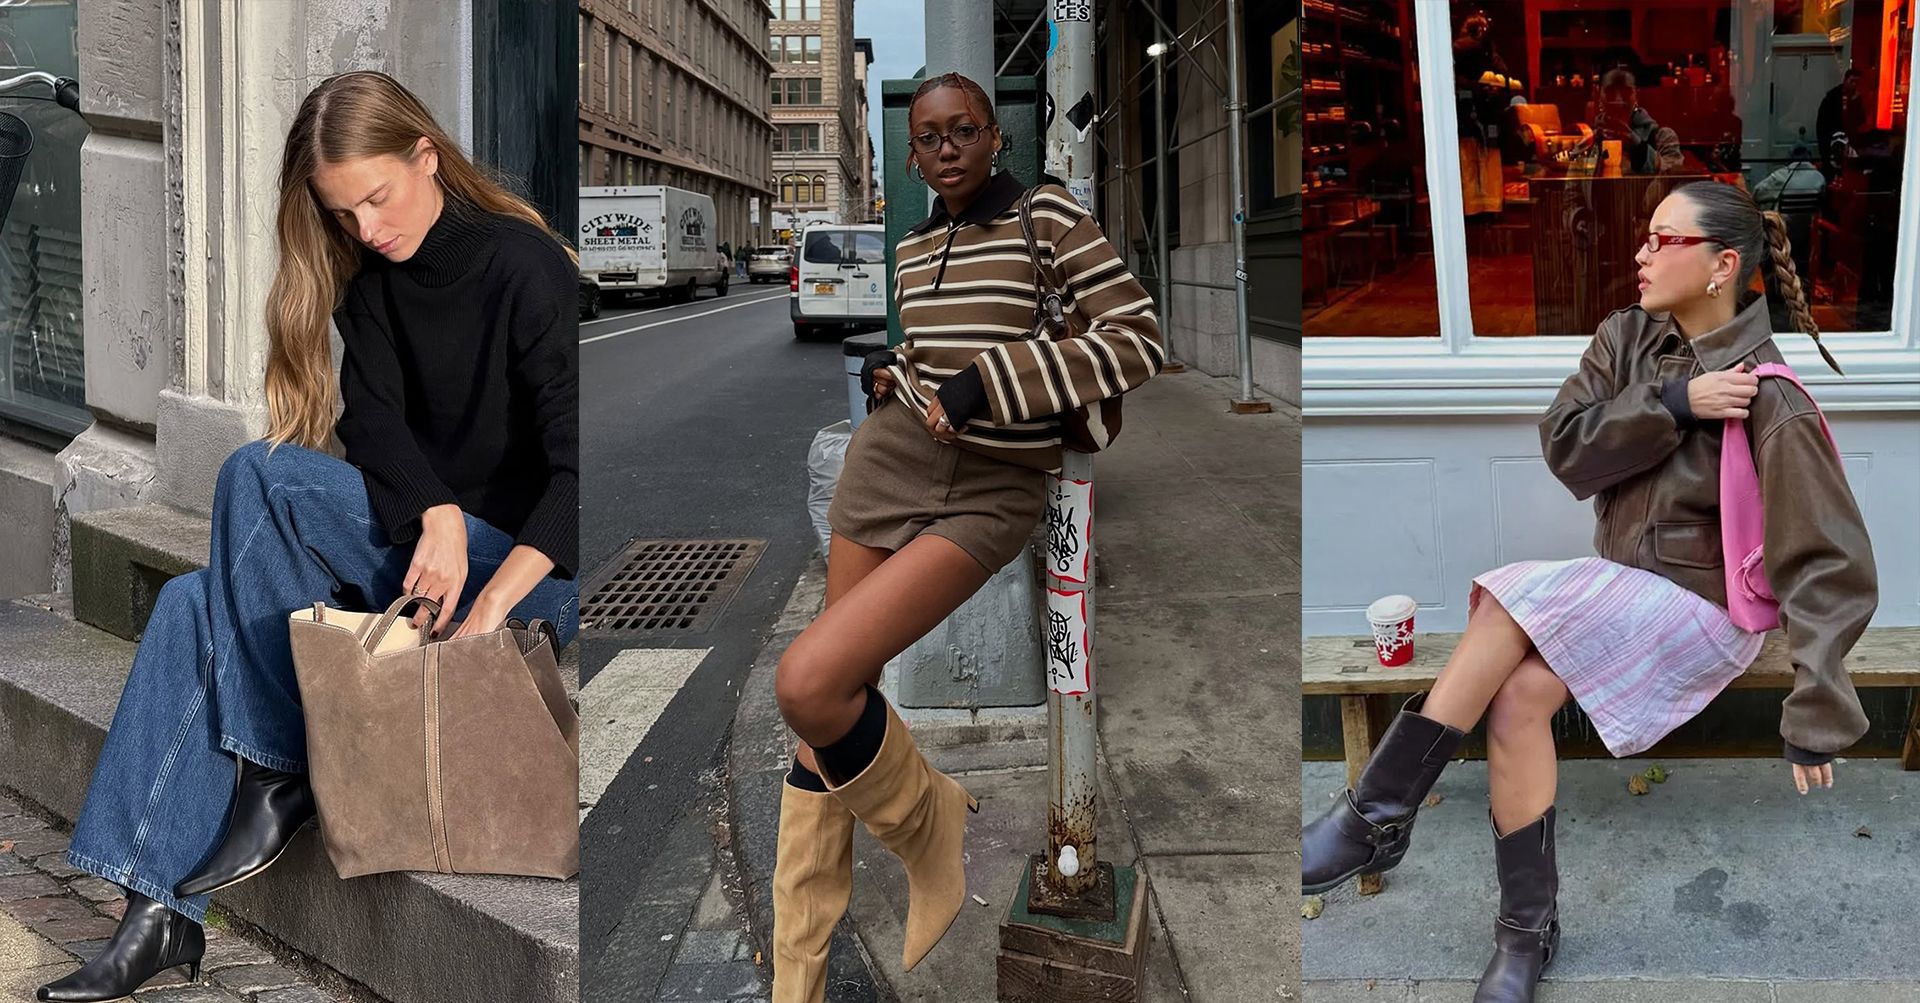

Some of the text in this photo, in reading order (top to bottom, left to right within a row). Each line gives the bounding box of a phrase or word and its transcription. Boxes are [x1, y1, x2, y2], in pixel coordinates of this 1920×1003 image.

[1056, 7, 1088, 20] LES
[581, 213, 654, 234] CITYWIDE
[584, 237, 651, 246] SHEET METAL
